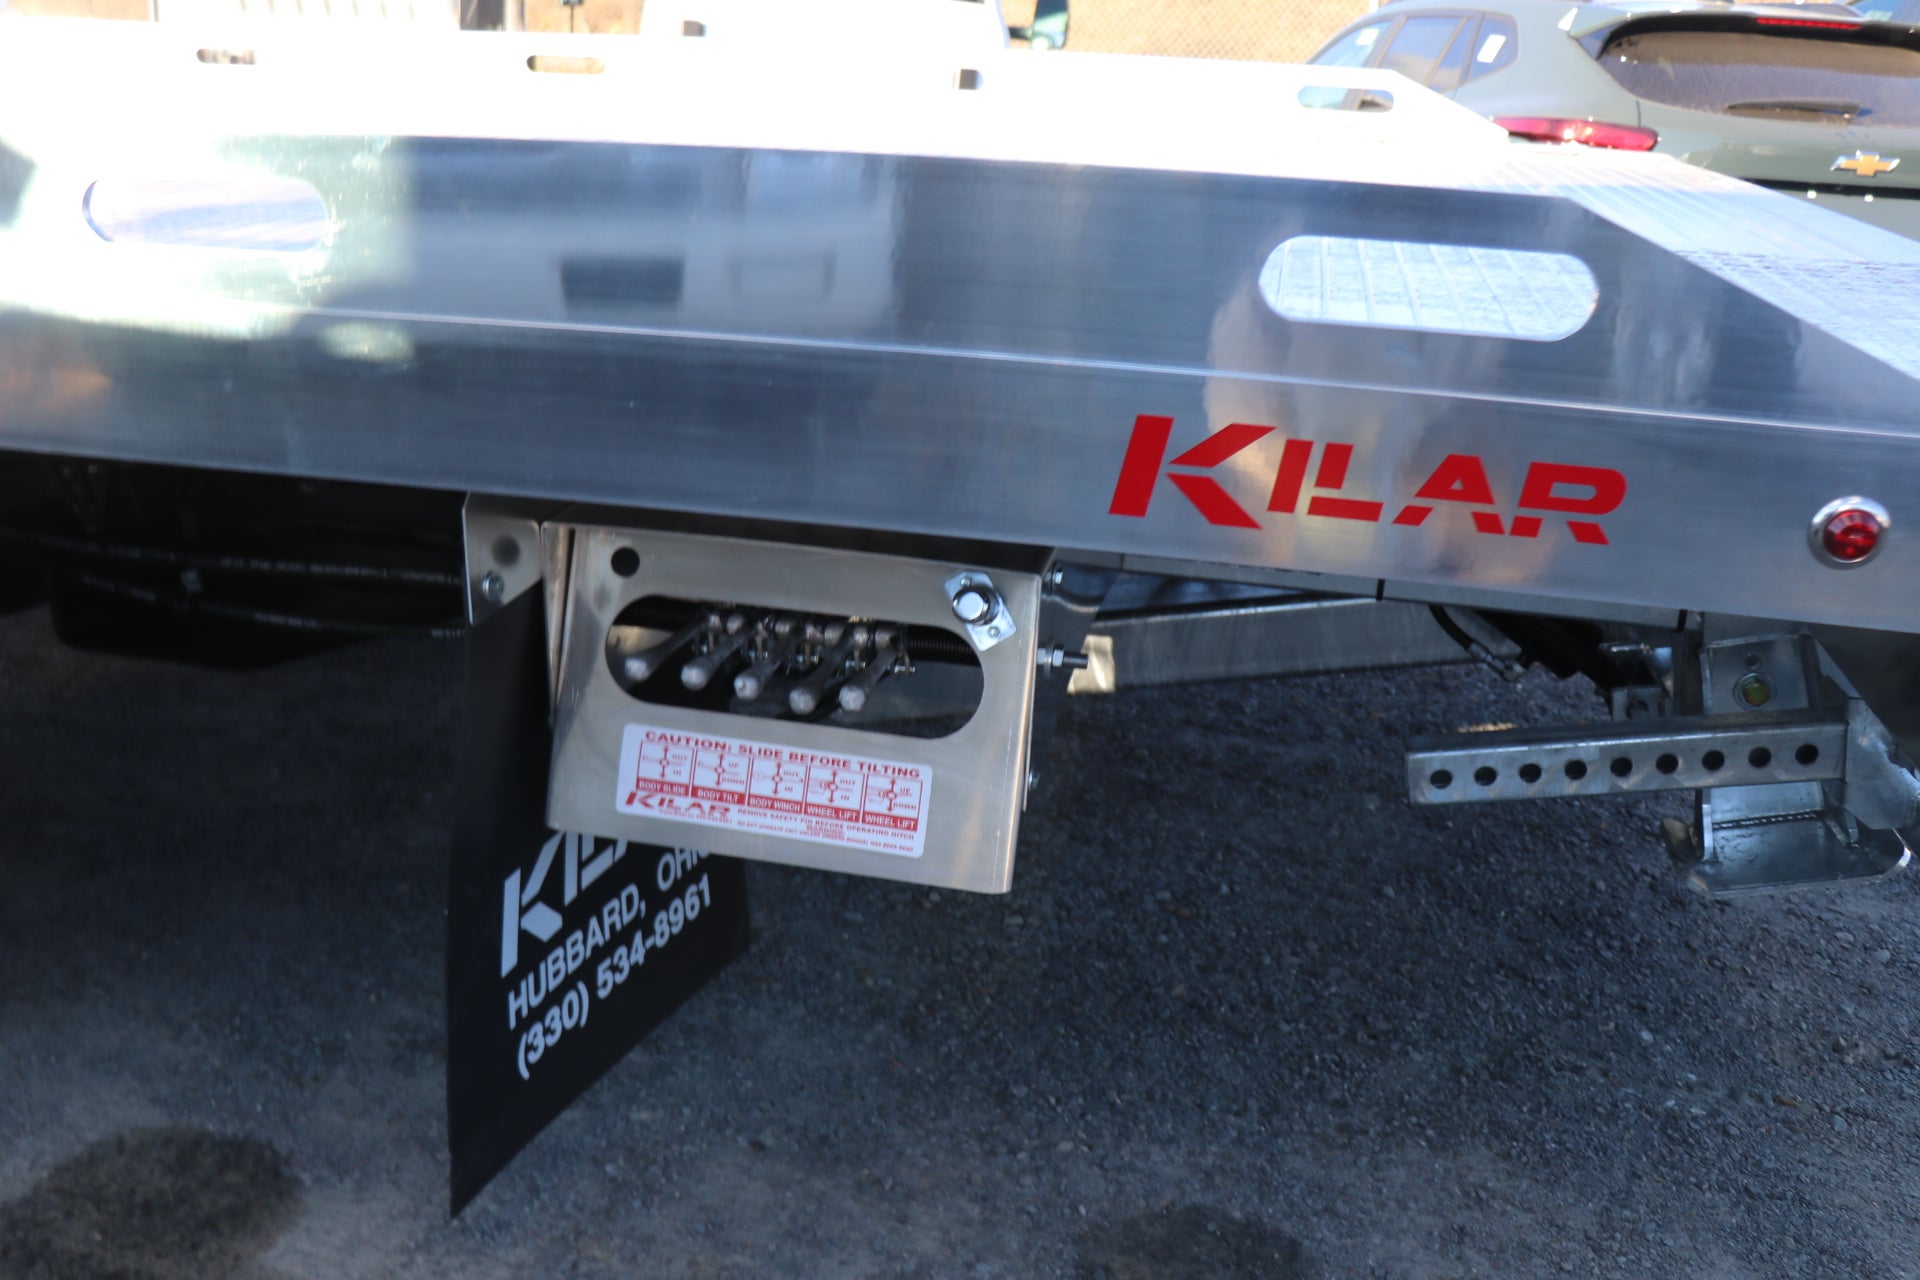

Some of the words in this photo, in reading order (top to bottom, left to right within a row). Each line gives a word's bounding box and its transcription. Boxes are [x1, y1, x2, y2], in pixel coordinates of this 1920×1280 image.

[1108, 414, 1627, 545] KILAR
[645, 731, 731, 750] CAUTION:
[738, 744, 782, 758] SLIDE
[788, 751, 850, 767] BEFORE
[857, 761, 920, 777] TILTING
[639, 779, 661, 791] BODY
[662, 783, 686, 795] SLIDE
[697, 788, 720, 800] BODY
[722, 791, 739, 803] TILT
[625, 791, 730, 817] KILAR
[749, 796, 772, 807] BODY
[773, 799, 800, 812] WINCH
[806, 804, 836, 817] WHEEL
[839, 809, 857, 820] LIFT
[846, 824, 888, 836] OPERATING
[865, 813, 895, 826] WHEEL
[897, 818, 915, 829] LIFT
[501, 831, 627, 979] KIL
[508, 883, 646, 1031] HUBBARD,
[657, 847, 709, 891] OHI
[518, 981, 589, 1080] (330)
[597, 873, 711, 999] 534-8961
